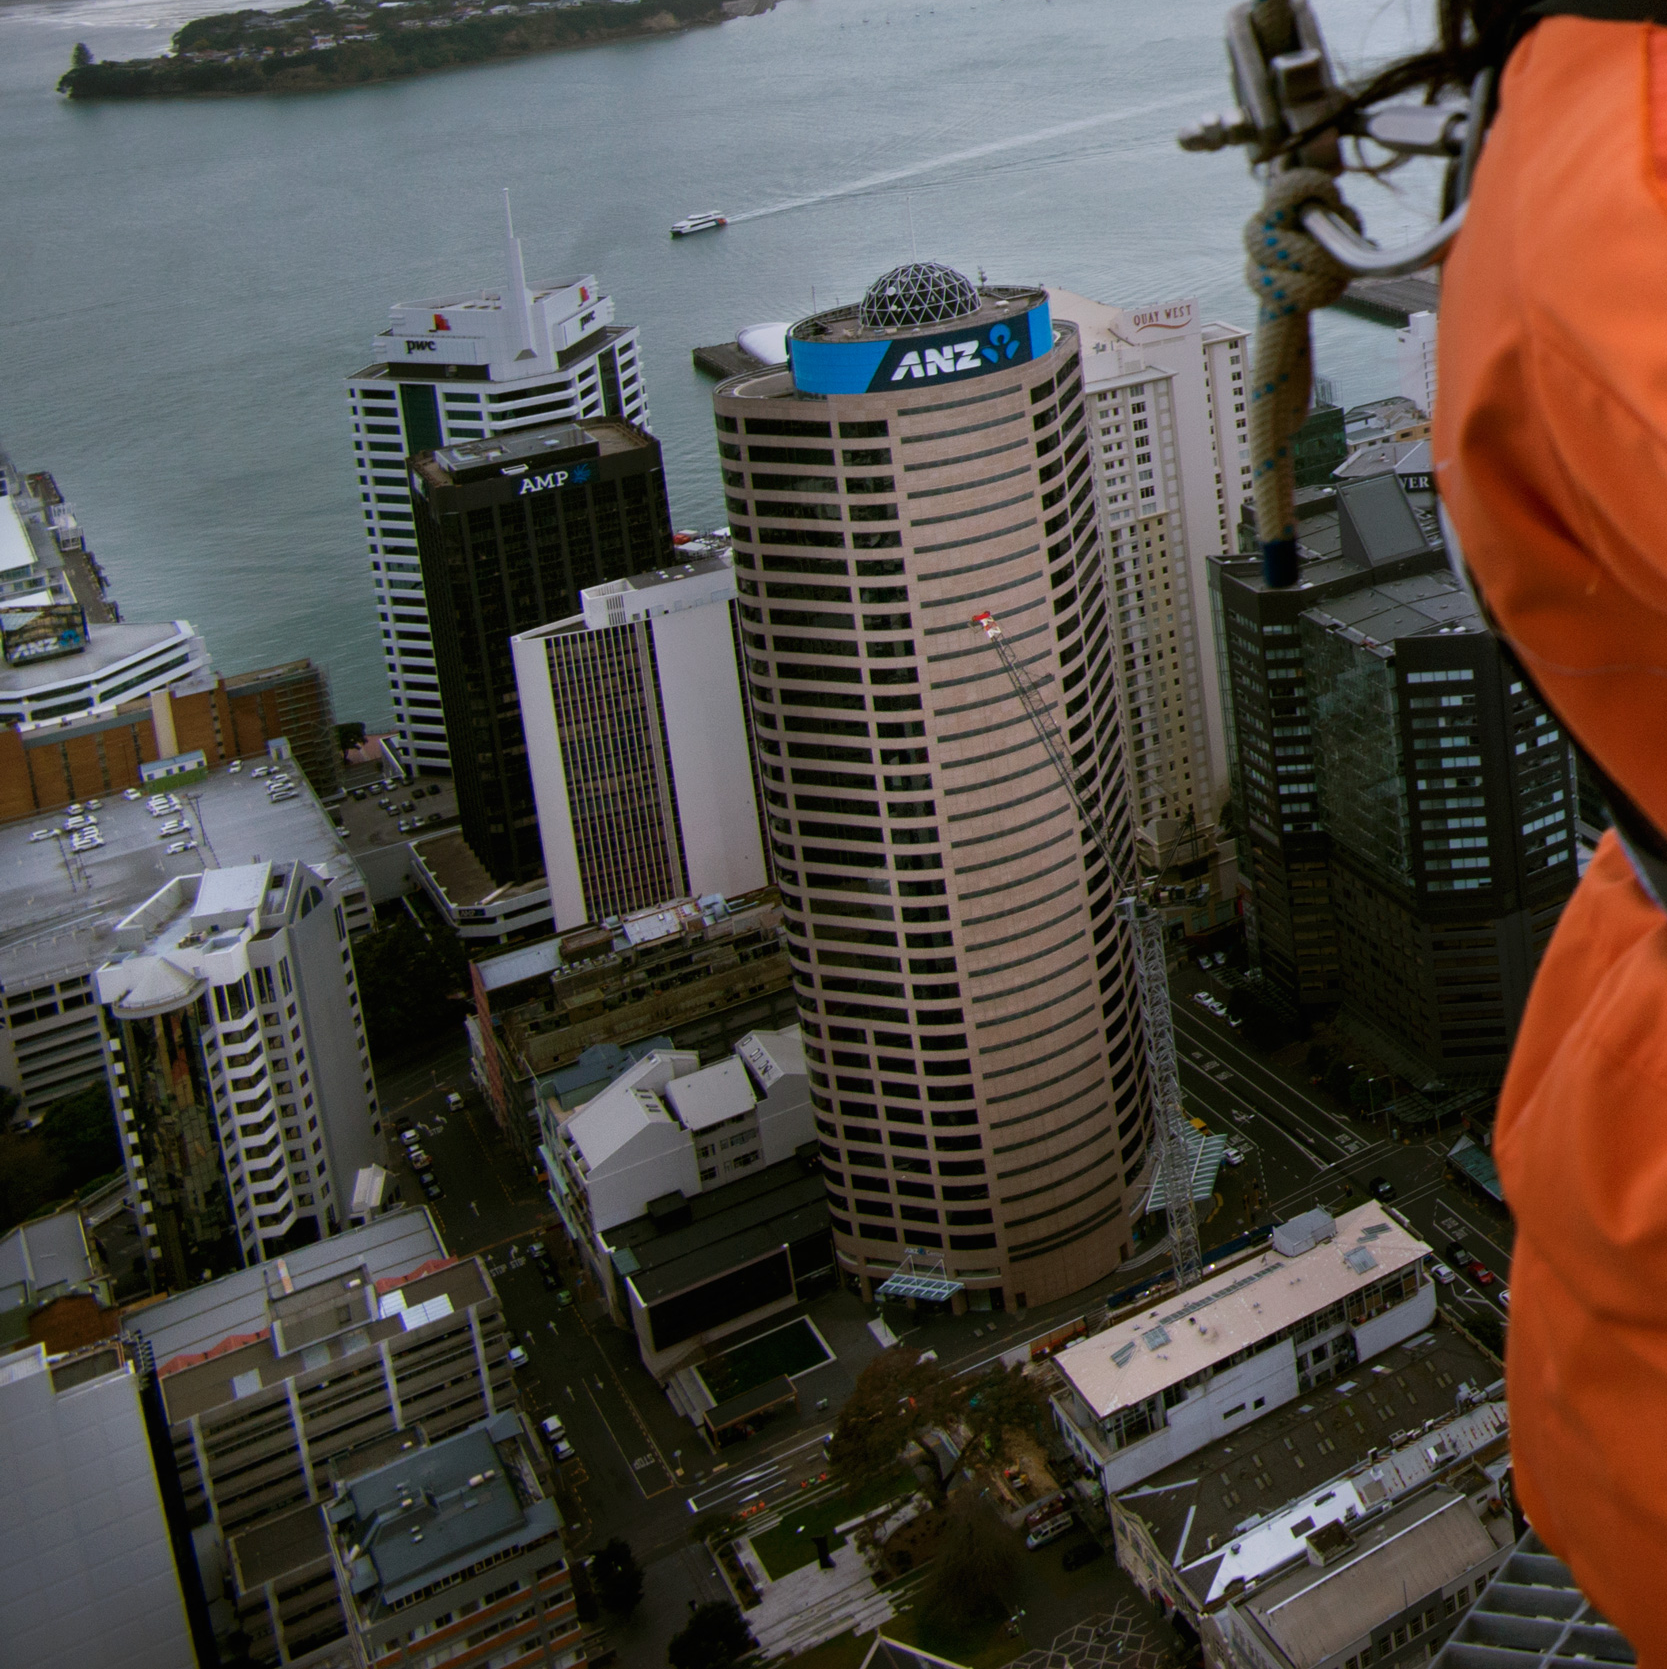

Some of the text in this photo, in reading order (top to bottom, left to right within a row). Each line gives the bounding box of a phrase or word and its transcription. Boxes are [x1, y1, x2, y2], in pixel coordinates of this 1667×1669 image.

[580, 310, 596, 331] pwc
[1133, 304, 1191, 326] QUAY WEST
[405, 340, 437, 354] pwc
[890, 340, 981, 381] ANZ
[519, 470, 568, 494] AMP
[10, 636, 59, 660] ANZ
